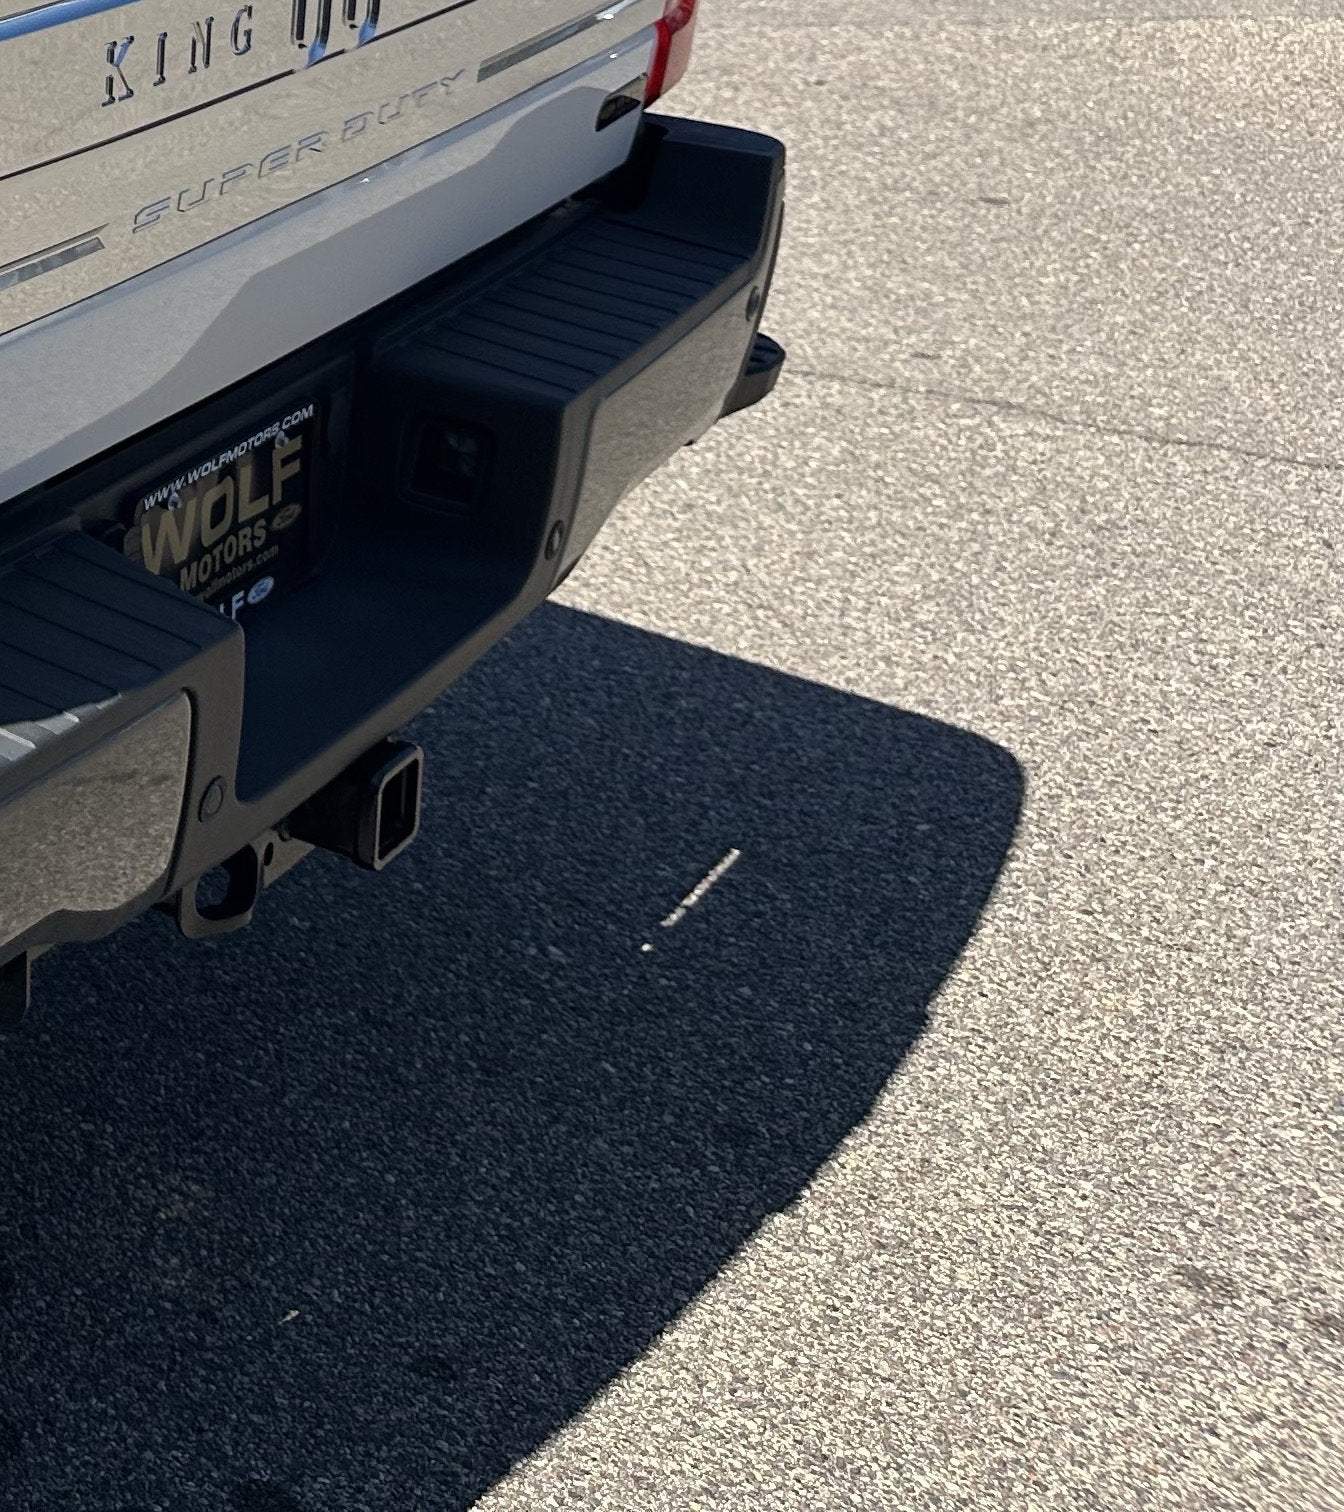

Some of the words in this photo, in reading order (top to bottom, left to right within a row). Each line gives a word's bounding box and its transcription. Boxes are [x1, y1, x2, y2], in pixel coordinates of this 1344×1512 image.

[102, 4, 254, 107] KING
[132, 130, 330, 234] SUPER
[340, 68, 467, 142] DUTY
[141, 434, 303, 576] WOLF
[143, 403, 314, 511] WWW.WOLFMOTORS.COM
[179, 517, 268, 591] MOTORS
